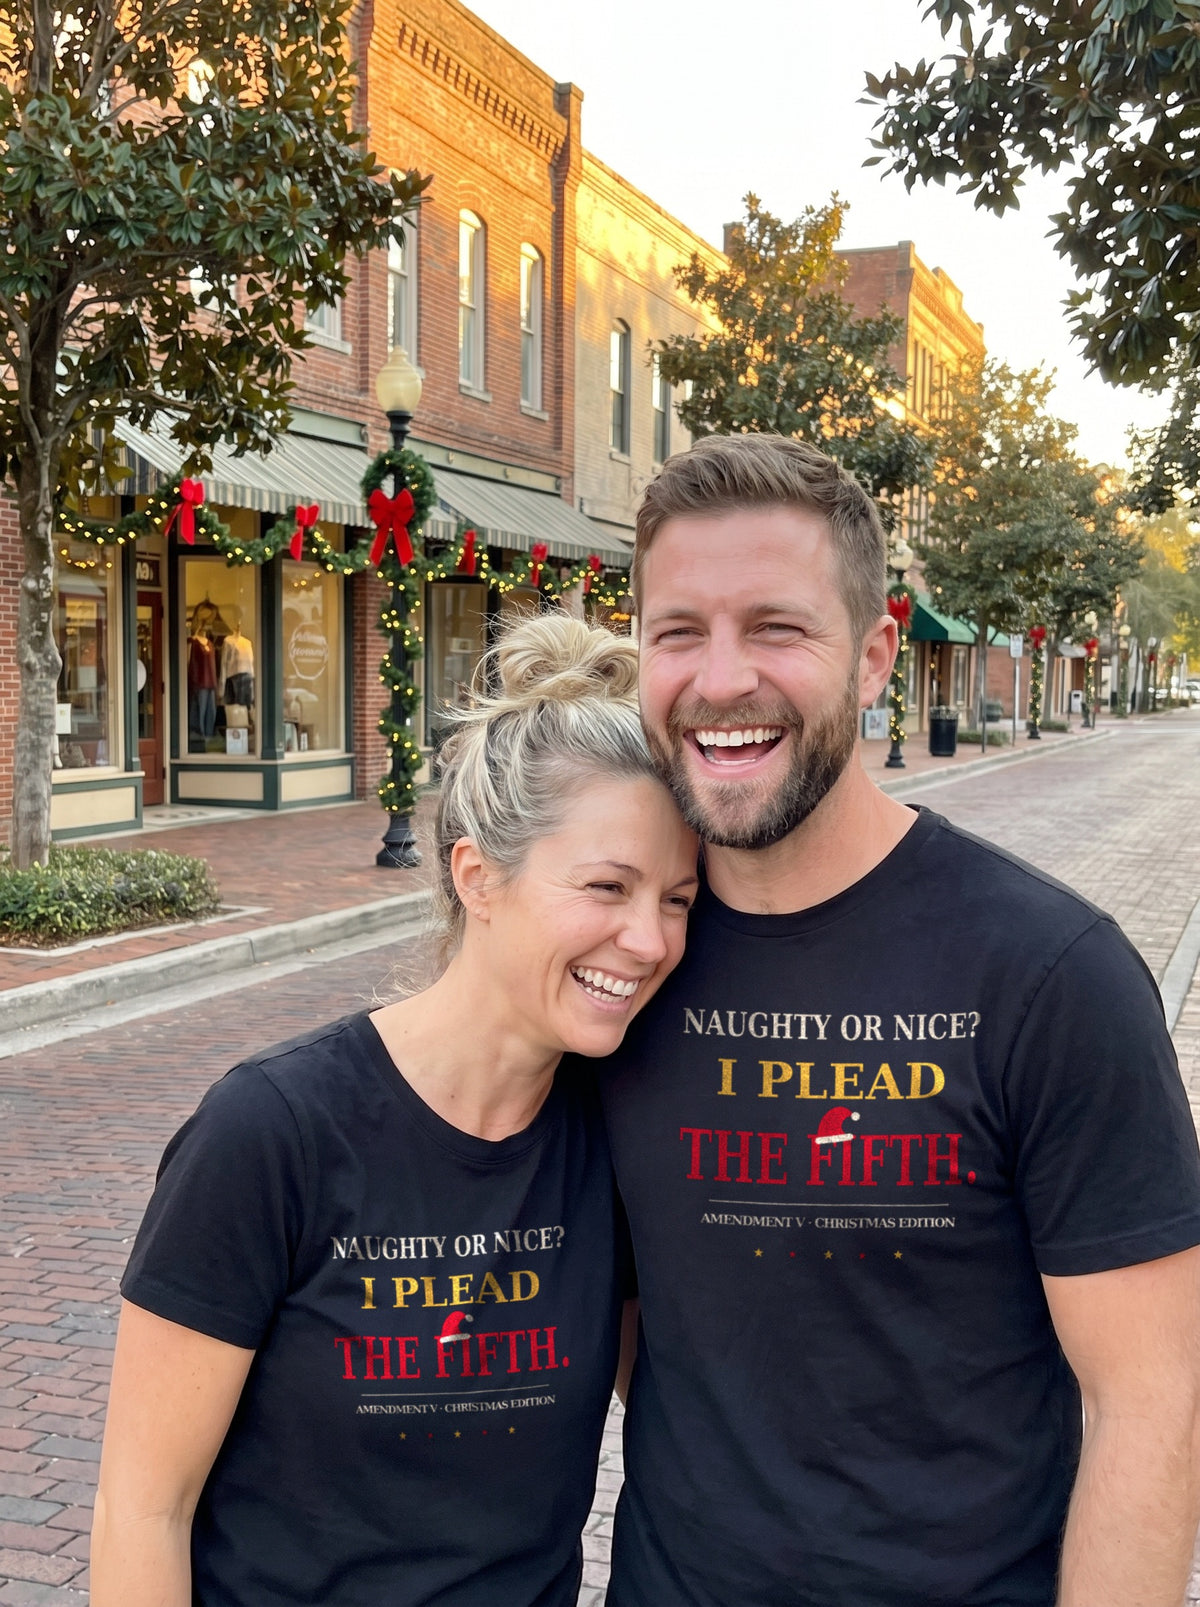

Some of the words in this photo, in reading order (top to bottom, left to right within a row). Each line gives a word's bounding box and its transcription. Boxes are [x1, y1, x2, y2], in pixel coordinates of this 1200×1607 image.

[684, 1008, 832, 1041] NAUGHTY
[840, 1013, 884, 1041] OR
[893, 1011, 981, 1041] NICE?
[717, 1058, 737, 1096] I
[758, 1060, 945, 1100] PLEAD
[680, 1128, 788, 1185] THE
[806, 1133, 977, 1186] FIFTH.
[701, 1213, 794, 1228] AMENDMENT
[795, 1216, 805, 1228] V
[815, 1217, 896, 1229] CHRISTMAS
[899, 1216, 956, 1229] EDITION
[332, 1235, 447, 1260] NAUGHTY
[454, 1233, 487, 1257] OR
[493, 1225, 566, 1254] NICE?
[360, 1277, 377, 1309] I
[392, 1270, 540, 1308] PLEAD
[334, 1336, 420, 1380] THE
[434, 1326, 570, 1378] FIFTH.
[356, 1404, 430, 1414] AMENDMENT
[430, 1404, 438, 1413] V
[445, 1401, 509, 1413] CHRISTMAS
[511, 1395, 555, 1408] EDITION
